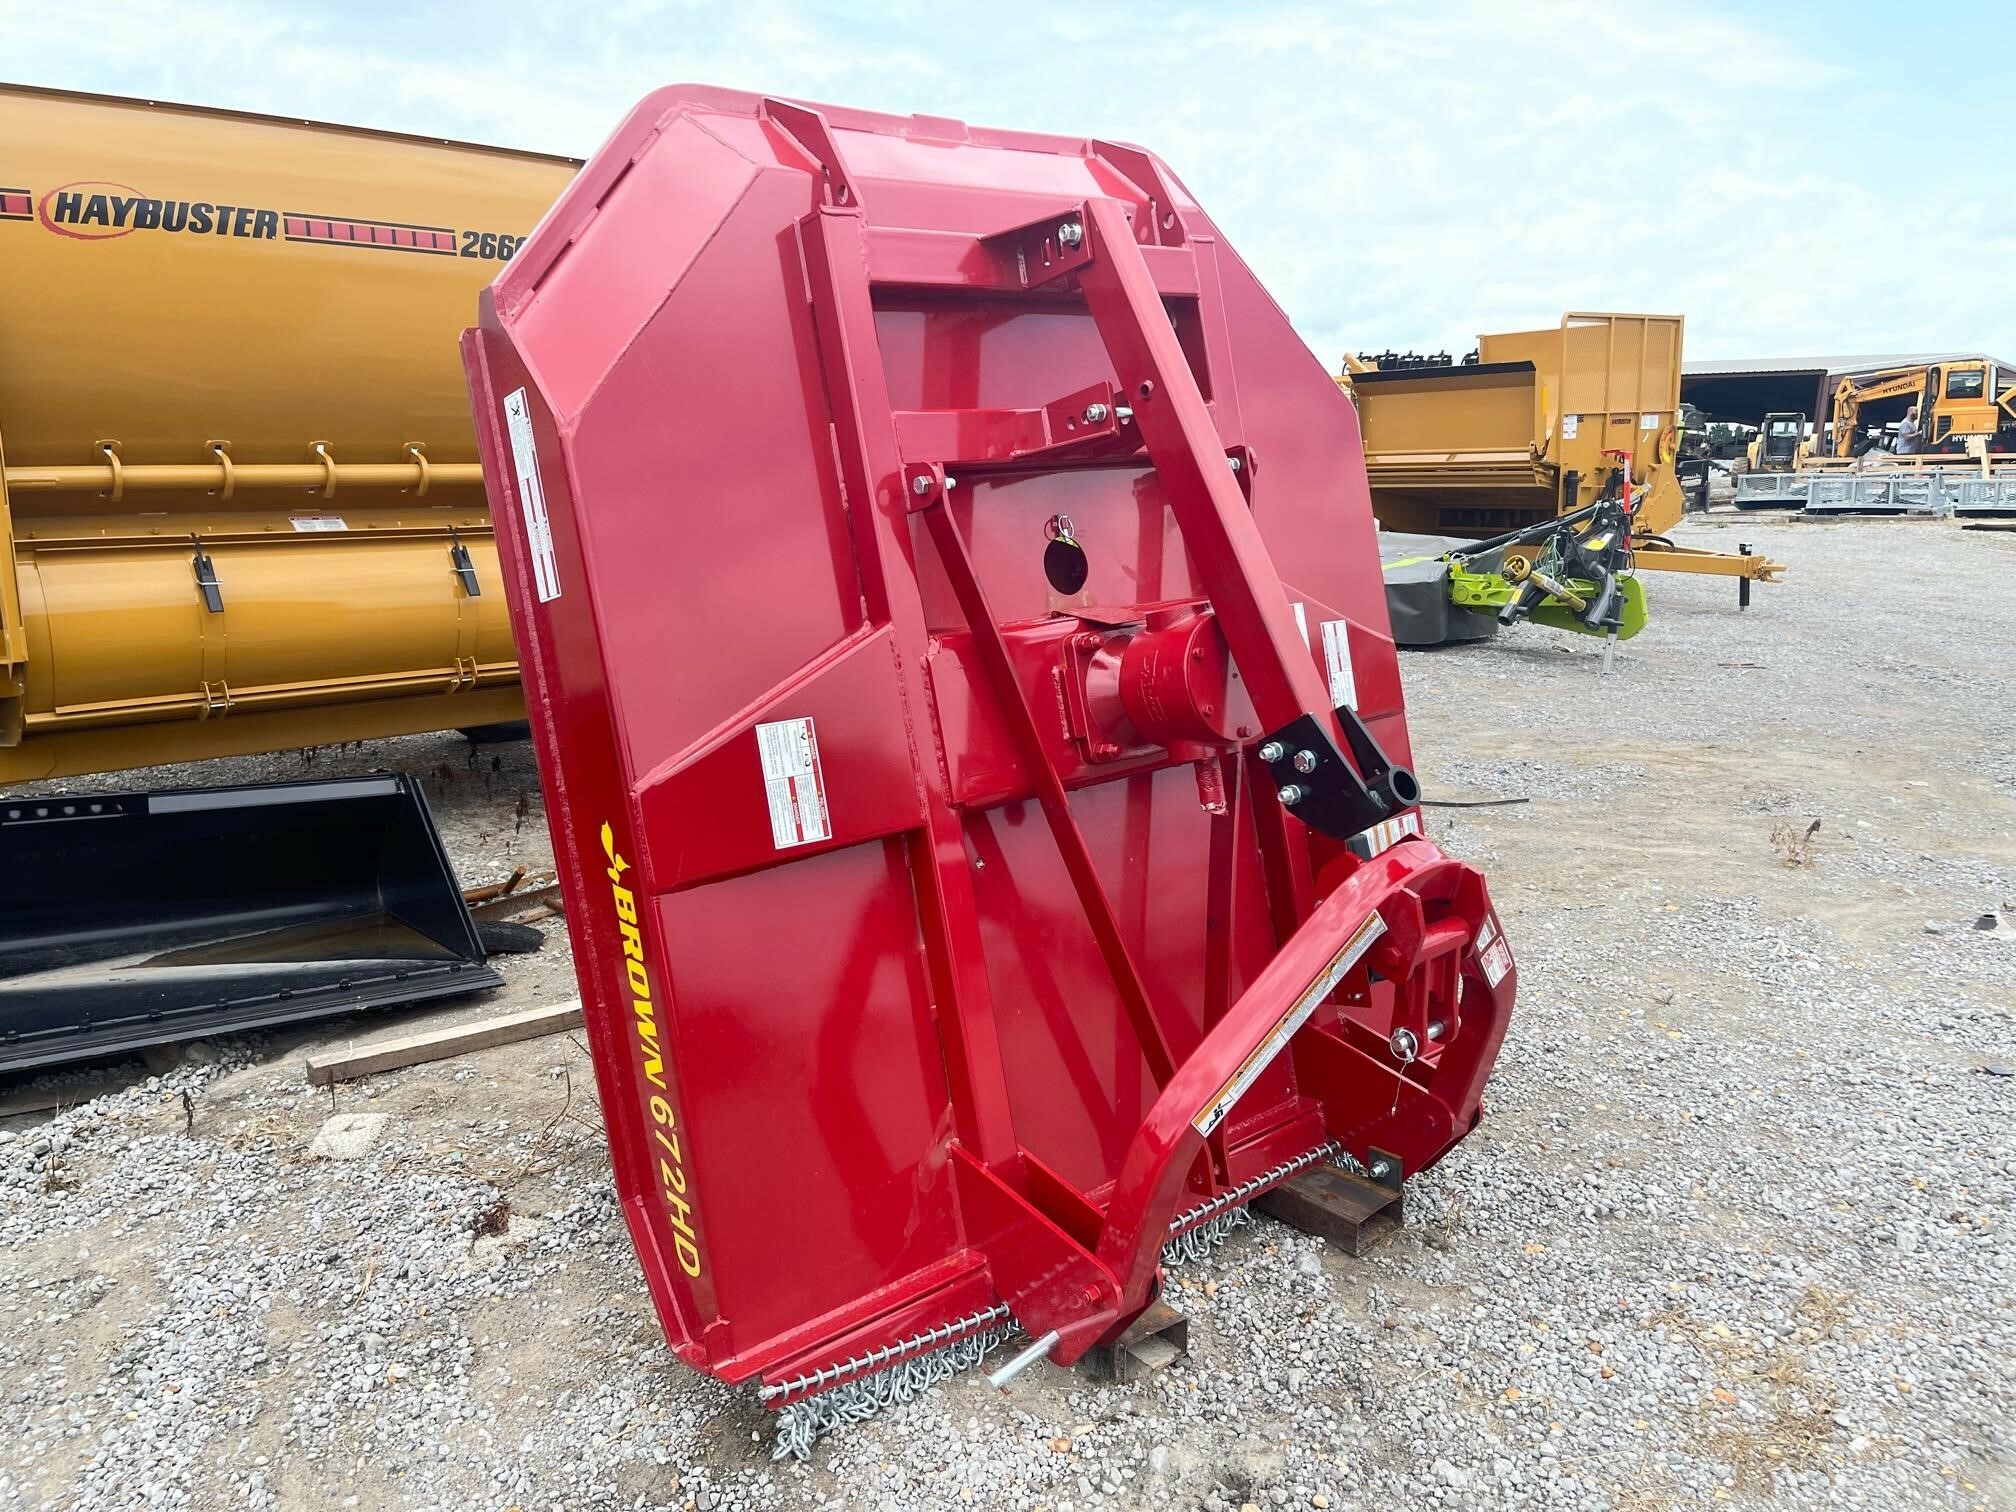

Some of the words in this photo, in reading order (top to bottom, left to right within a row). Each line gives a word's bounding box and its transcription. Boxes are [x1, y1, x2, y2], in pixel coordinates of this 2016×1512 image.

[54, 192, 278, 240] HAYBUSTER
[1882, 381, 1916, 394] HYUNDAI
[612, 883, 668, 1090] BROWN
[649, 1095, 701, 1279] 672HD
